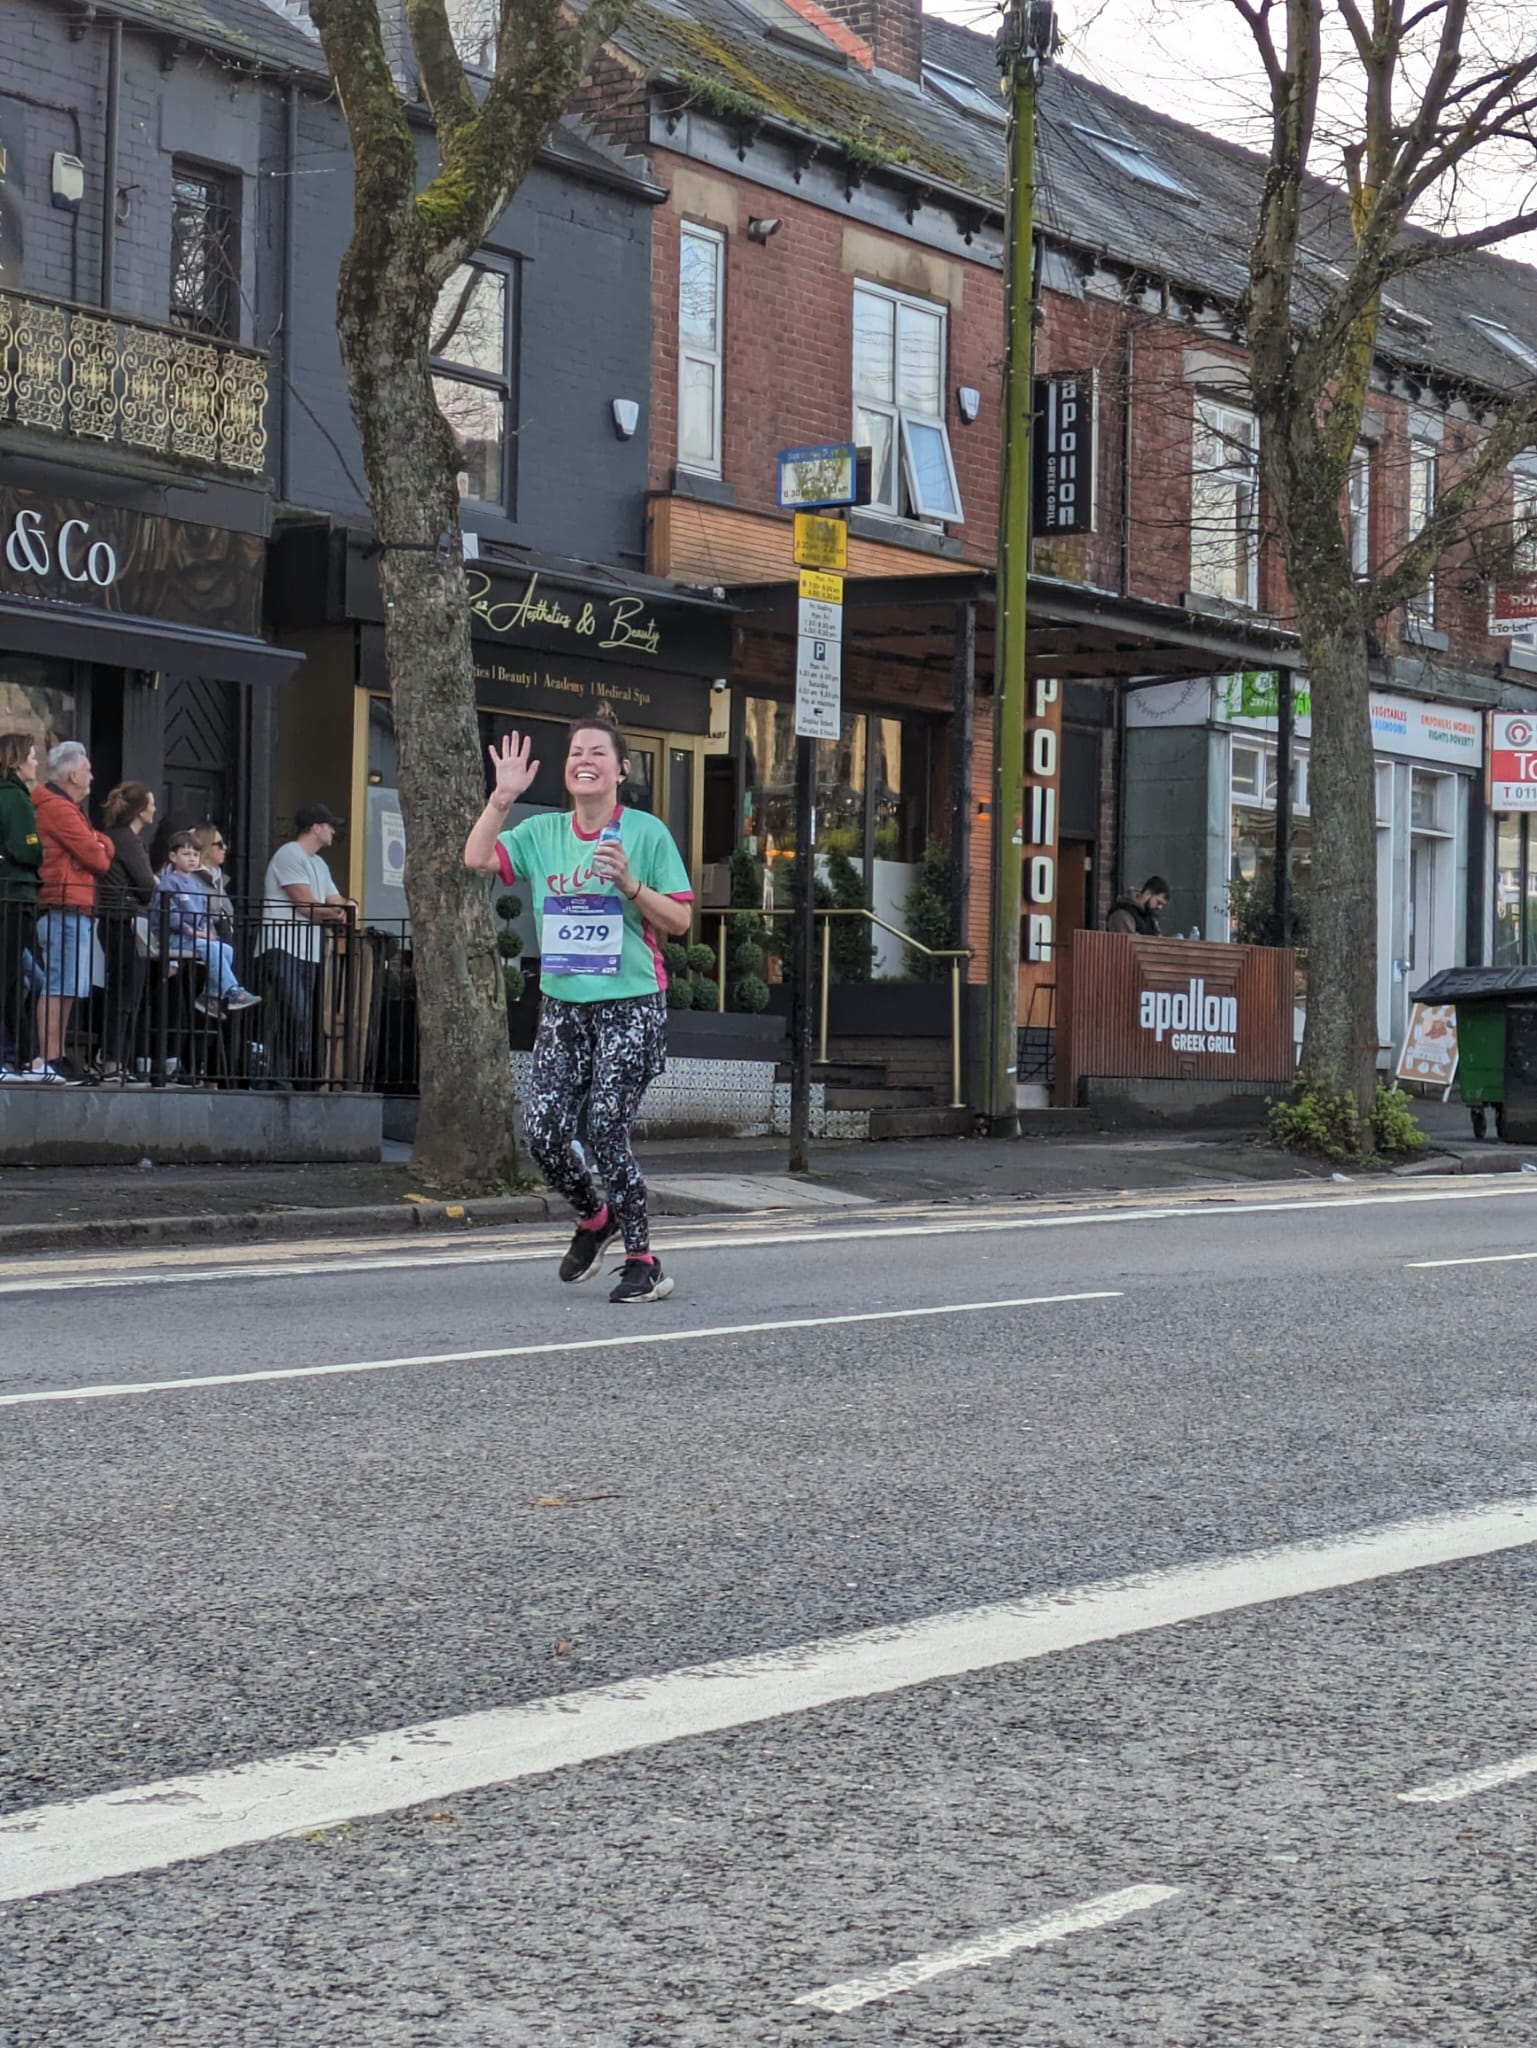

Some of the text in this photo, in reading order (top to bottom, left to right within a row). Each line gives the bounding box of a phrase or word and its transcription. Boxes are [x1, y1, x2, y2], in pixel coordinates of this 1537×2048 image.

[1047, 457, 1057, 527] GREEK GRILL
[6, 509, 116, 586] & Co
[488, 572, 571, 632] Aesthetics
[576, 602, 596, 635] &
[599, 597, 661, 654] Beauty
[1496, 622, 1529, 633] To Let
[816, 643, 824, 659] P
[498, 666, 532, 688] Beauty
[544, 672, 585, 696] Academy
[597, 682, 632, 700] Medical
[633, 687, 651, 706] Spa
[1504, 786, 1511, 799] T
[558, 924, 610, 941] 6279
[1140, 978, 1237, 1042] apollon
[1172, 1034, 1236, 1054] GREEK GRILL
